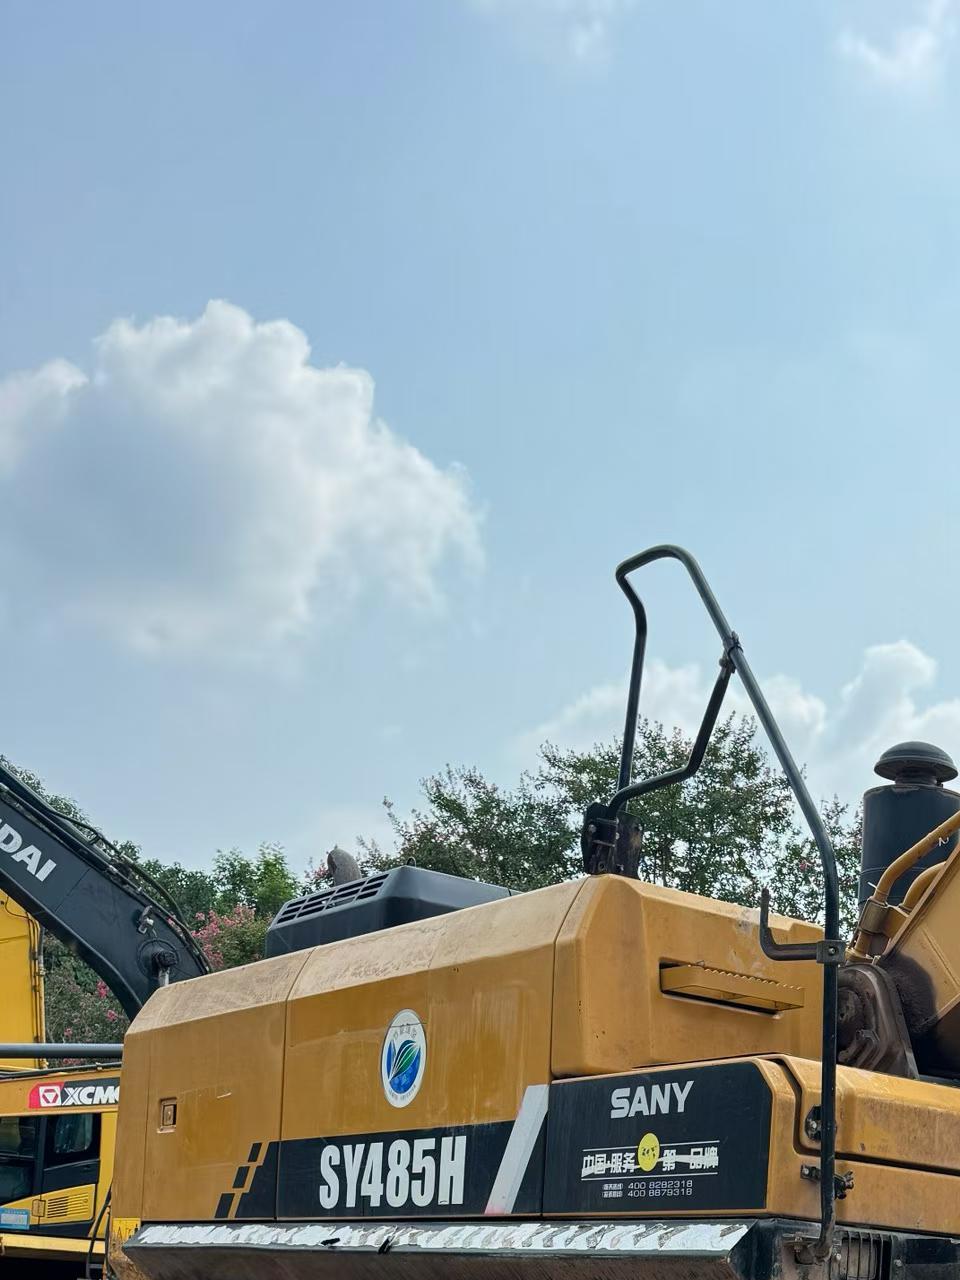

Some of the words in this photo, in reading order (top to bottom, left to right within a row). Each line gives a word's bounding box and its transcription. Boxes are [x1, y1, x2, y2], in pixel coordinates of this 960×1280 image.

[0, 819, 57, 882] DAI
[610, 1080, 695, 1119] SANY
[319, 1135, 467, 1210] SY485H
[628, 1182, 646, 1190] 400
[648, 1179, 693, 1189] 8282318
[627, 1189, 646, 1198] 400
[648, 1187, 693, 1197] 8879318
